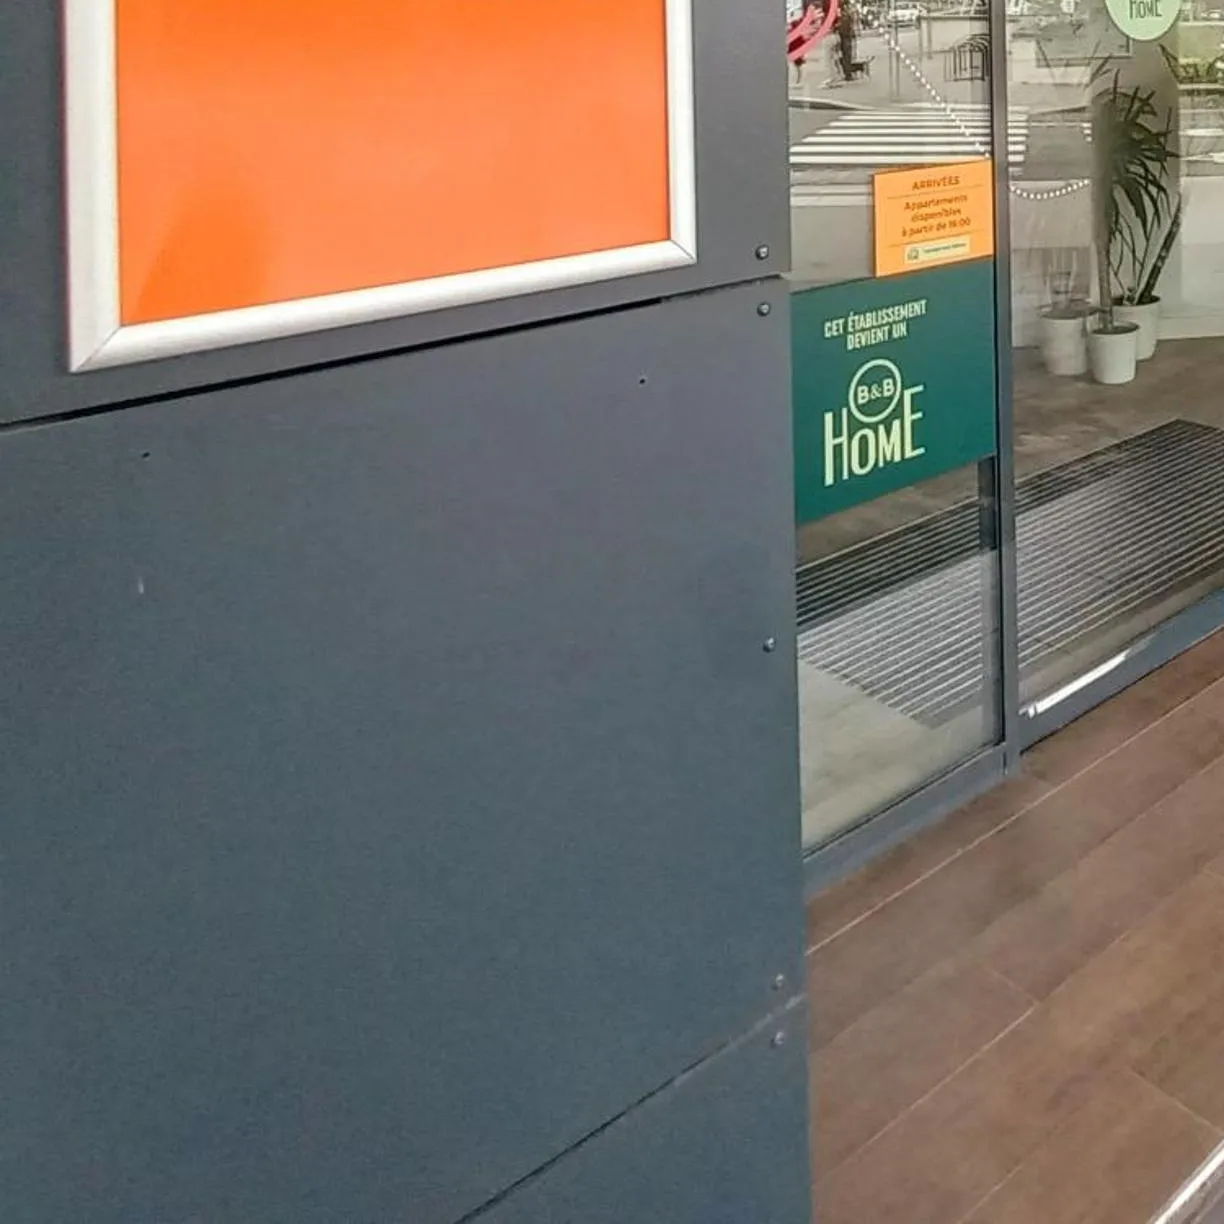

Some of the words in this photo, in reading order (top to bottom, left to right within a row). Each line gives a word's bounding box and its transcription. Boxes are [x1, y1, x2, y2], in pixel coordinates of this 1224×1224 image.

[903, 194, 968, 211] Appartements
[824, 317, 845, 338] CET
[847, 299, 928, 332] ÉTABLISSEMENT
[846, 327, 890, 351] DEVIENT
[891, 320, 908, 338] UN
[856, 377, 896, 405] B&B
[823, 384, 926, 487] HOME
